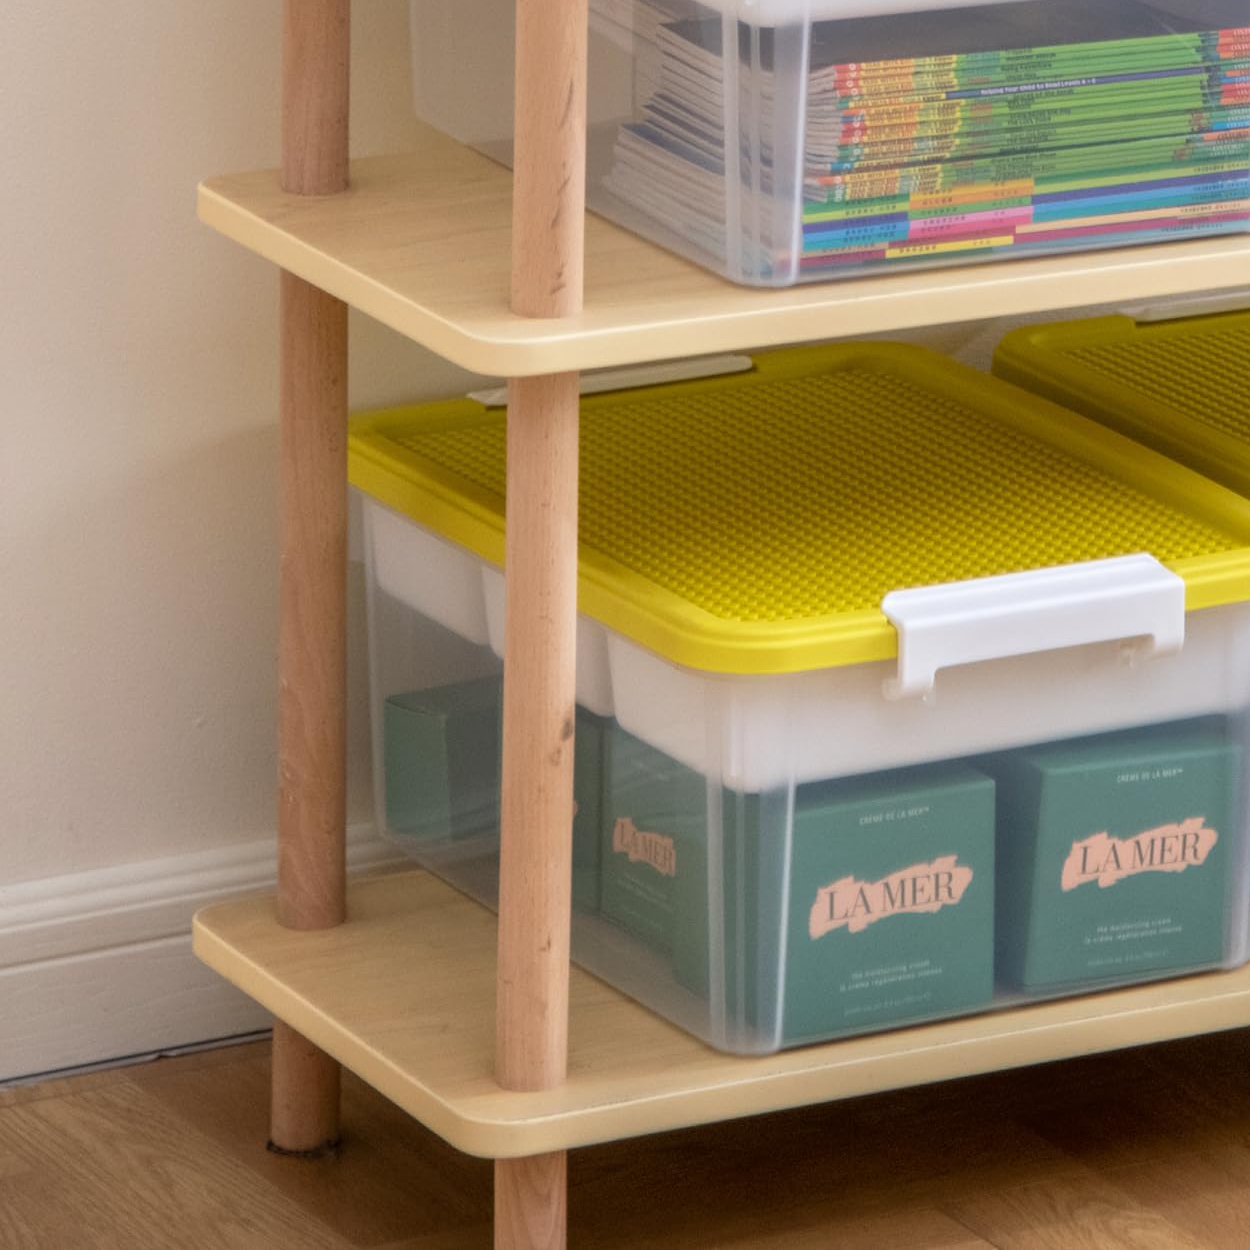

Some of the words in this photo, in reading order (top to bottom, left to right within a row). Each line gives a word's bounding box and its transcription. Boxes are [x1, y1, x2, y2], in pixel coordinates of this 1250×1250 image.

[1079, 842, 1122, 876] LA
[1130, 831, 1201, 870] MER
[826, 885, 873, 923] LA
[879, 870, 957, 913] MER
